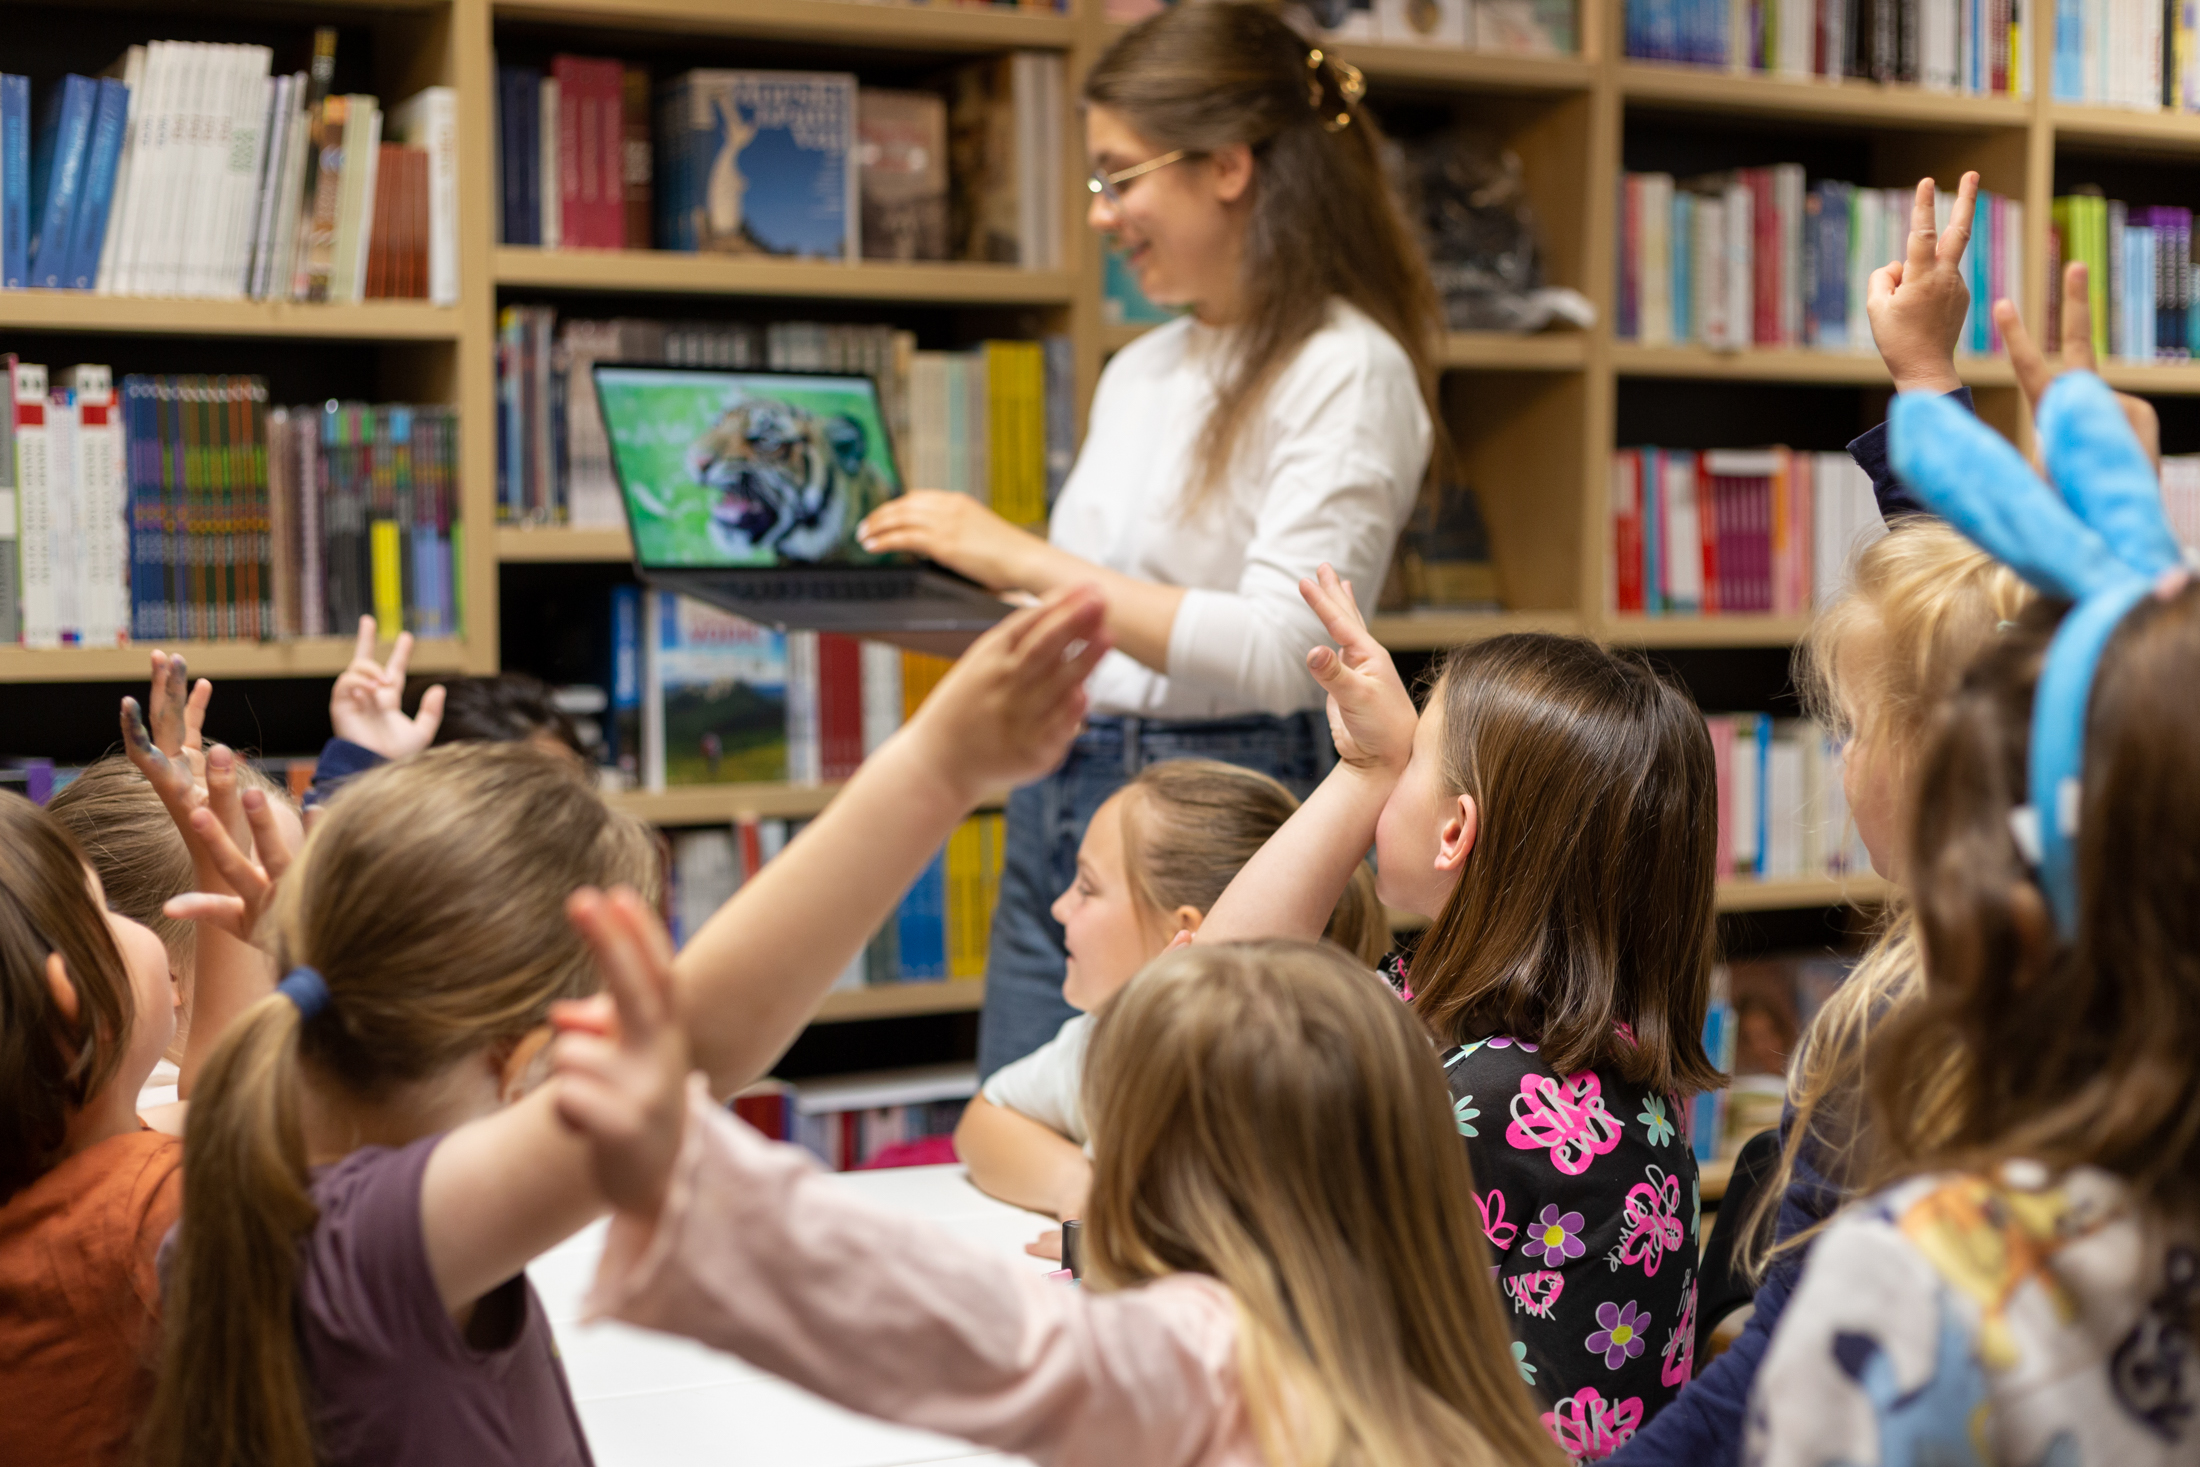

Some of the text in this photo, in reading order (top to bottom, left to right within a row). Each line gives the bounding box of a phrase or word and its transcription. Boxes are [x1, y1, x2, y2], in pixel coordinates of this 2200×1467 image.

[1509, 1072, 1595, 1148] GRL
[1555, 1095, 1626, 1173] PWR
[1514, 1295, 1557, 1322] PWR
[1553, 1397, 1636, 1456] GRL
